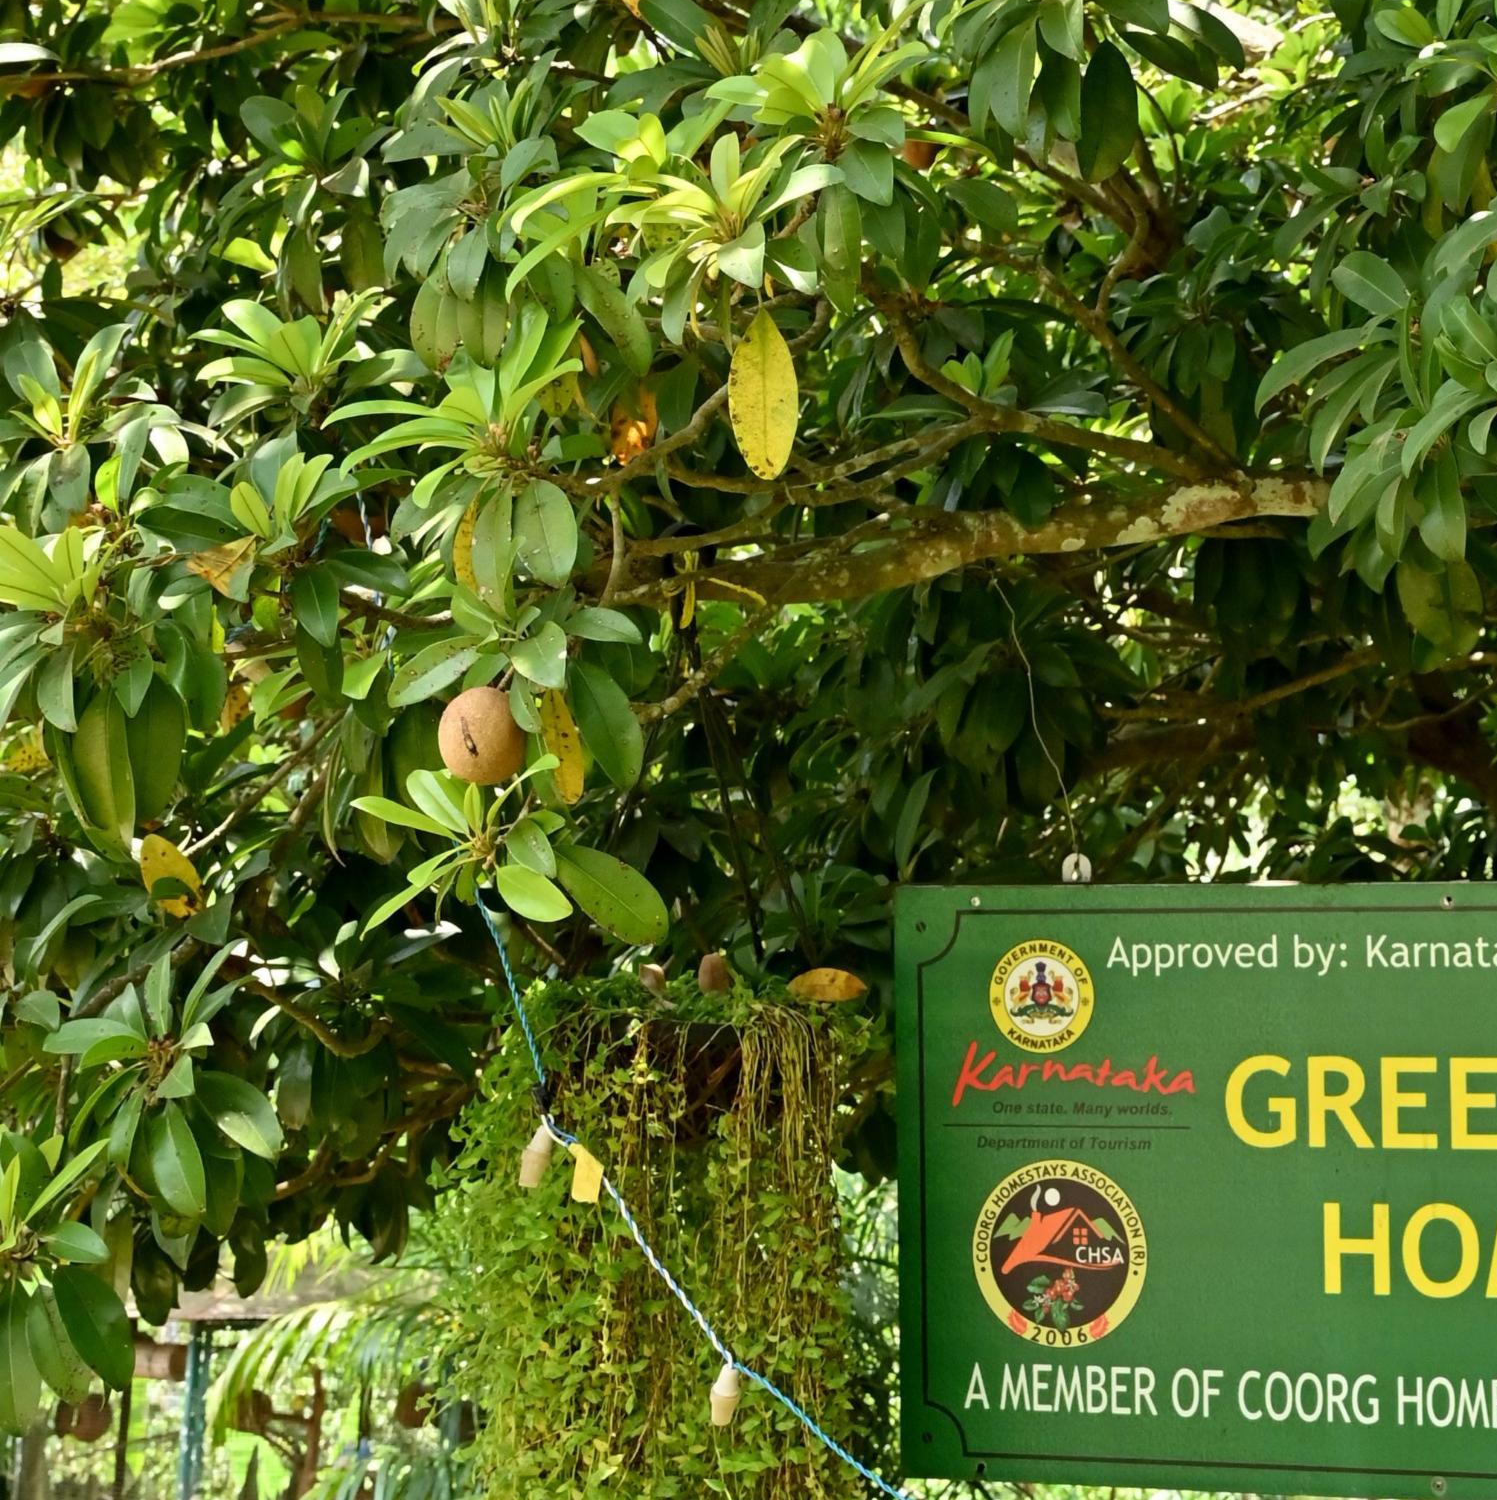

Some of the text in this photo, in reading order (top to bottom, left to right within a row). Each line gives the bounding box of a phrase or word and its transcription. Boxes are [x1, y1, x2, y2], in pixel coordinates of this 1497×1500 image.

[994, 943, 1088, 985] GOVERNMENT OF
[1106, 935, 1278, 976] Approved
[1294, 935, 1348, 976] by:
[1007, 1028, 1075, 1050] KARNATAKA
[952, 1041, 1195, 1107] Karnataka
[992, 1101, 1173, 1118] One state. Many worlds.
[977, 1135, 1151, 1151] Department of Tourism
[976, 1163, 1146, 1267] COORG HOMESTAYS ASSOCIATION (R)
[1075, 1246, 1125, 1264] CHSA
[1031, 1326, 1088, 1346] 2006
[964, 1362, 990, 1409] A
[1000, 1363, 1158, 1416] MEMBER
[1171, 1368, 1224, 1418] OF
[1238, 1370, 1379, 1425] COORG
